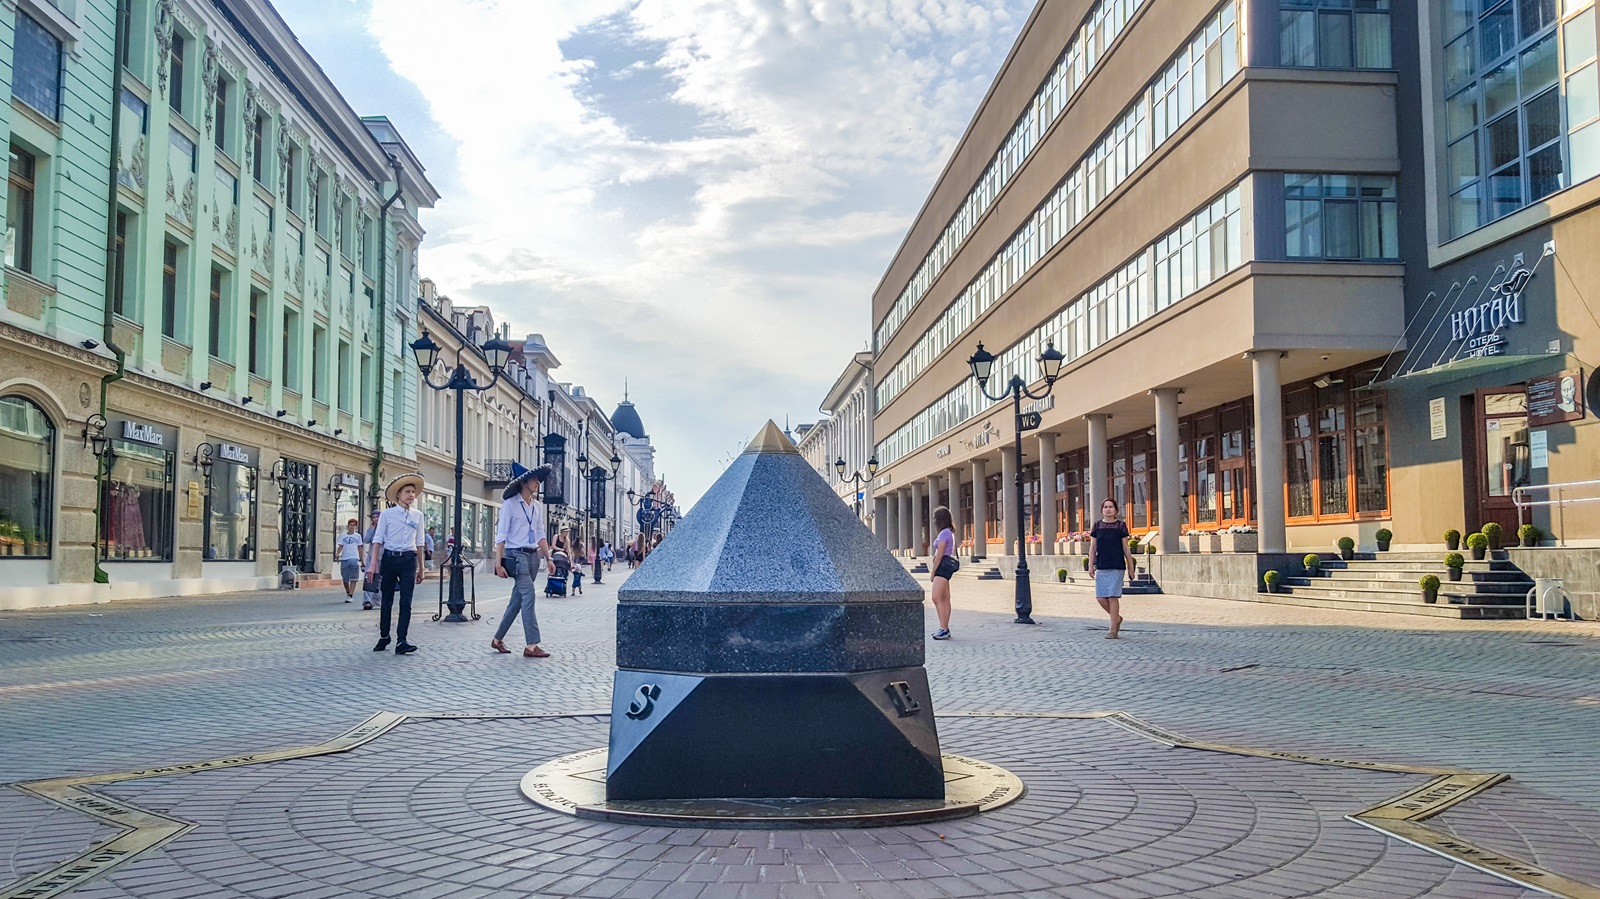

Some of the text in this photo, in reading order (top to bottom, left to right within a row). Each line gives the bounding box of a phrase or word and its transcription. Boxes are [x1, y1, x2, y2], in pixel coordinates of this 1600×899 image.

[1469, 334, 1500, 348] ОТЕЛЬ
[1469, 345, 1500, 357] HOTEL
[123, 421, 163, 444] MaxMara
[1021, 414, 1036, 428] WC
[626, 684, 662, 720] S
[886, 681, 920, 717] E
[8, 849, 130, 899] ДО МЕКК
